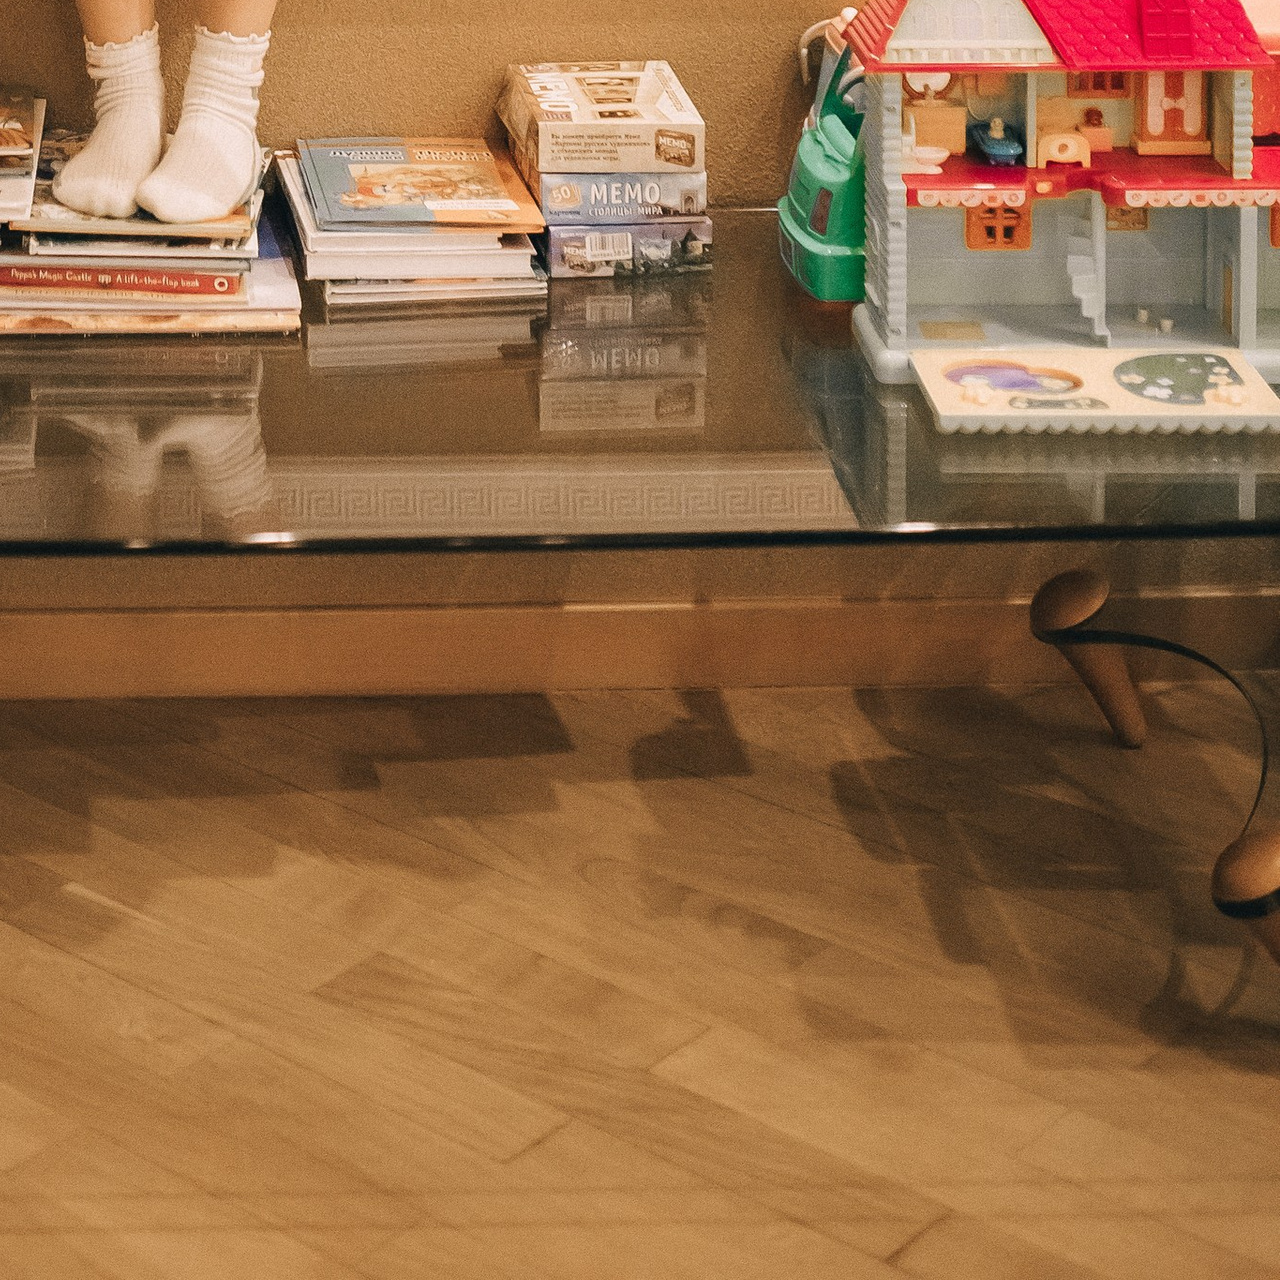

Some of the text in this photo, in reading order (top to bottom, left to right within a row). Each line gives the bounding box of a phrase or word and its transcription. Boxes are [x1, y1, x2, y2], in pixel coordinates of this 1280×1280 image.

[552, 186, 571, 203] 50
[590, 182, 662, 205] МЕМО
[588, 206, 664, 218] СТОЛИЦЫ МИРА
